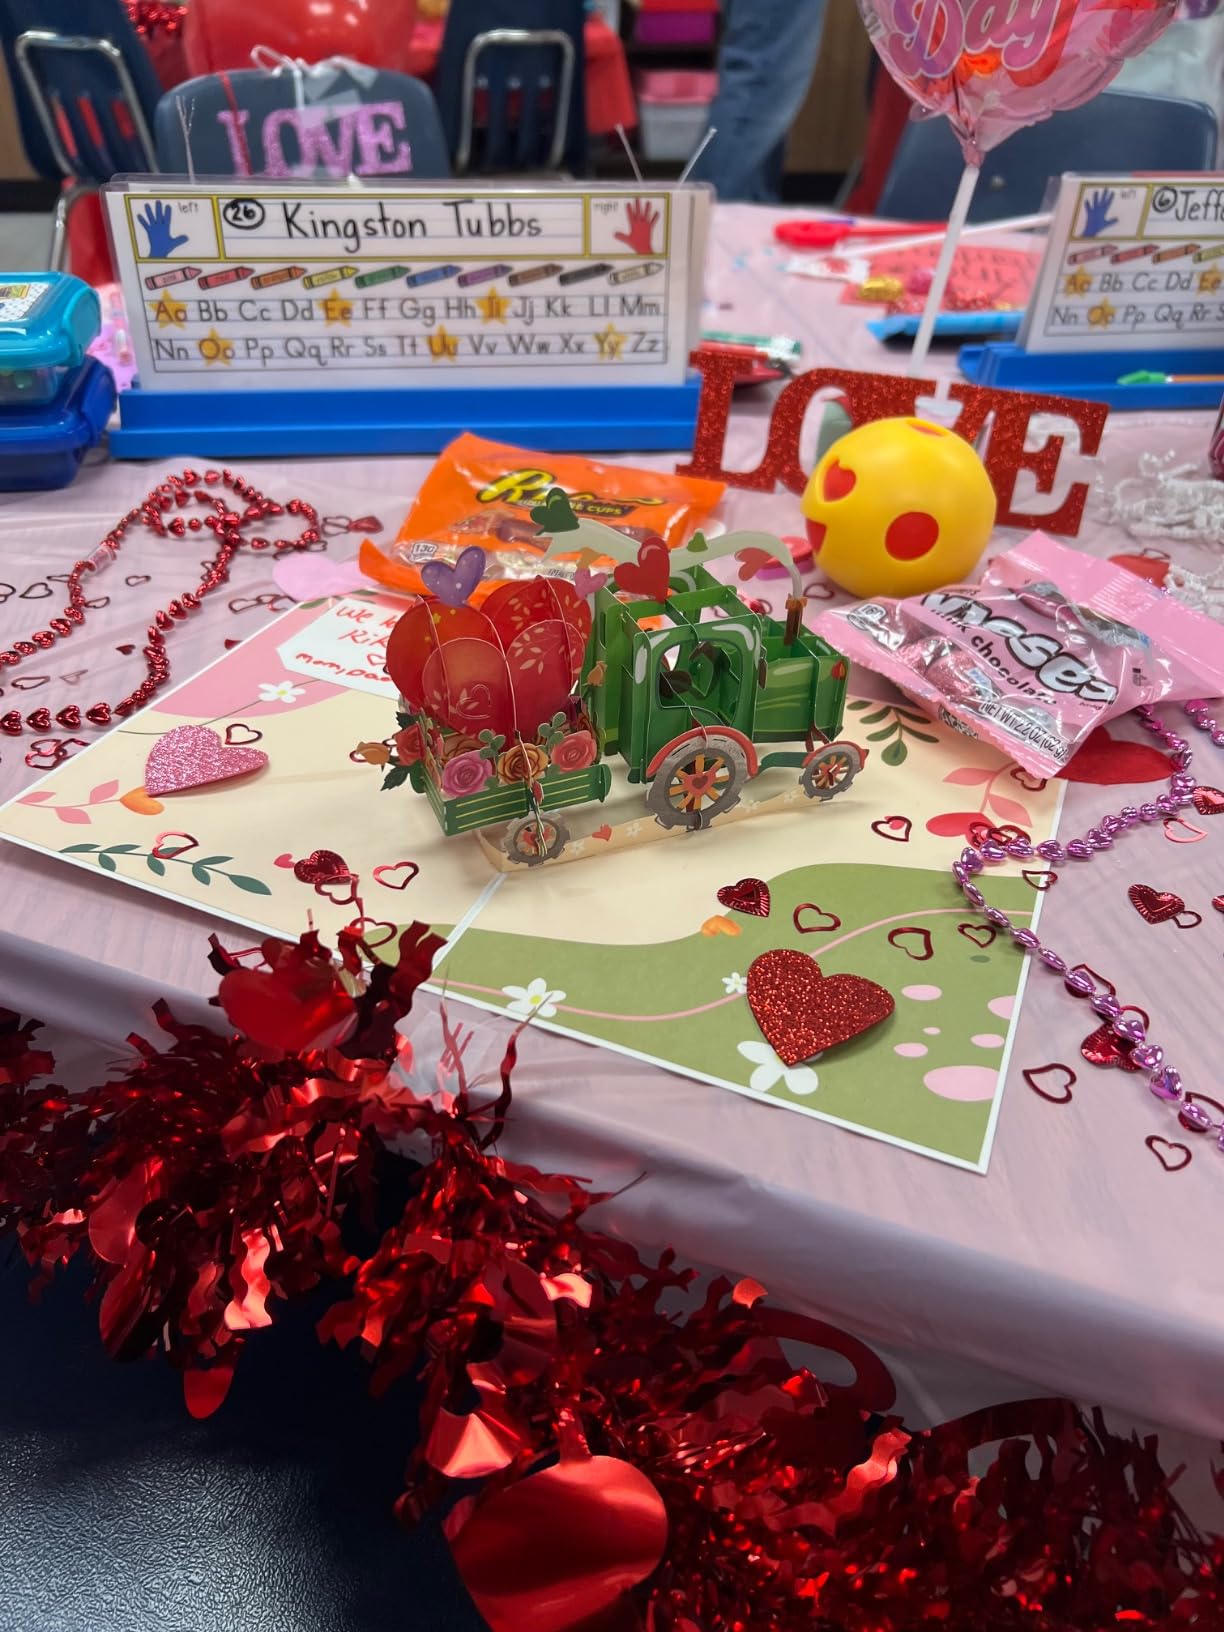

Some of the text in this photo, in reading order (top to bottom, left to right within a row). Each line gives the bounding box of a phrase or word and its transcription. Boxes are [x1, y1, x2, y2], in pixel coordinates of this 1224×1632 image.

[178, 202, 199, 214] left
[593, 202, 618, 216] right
[282, 198, 542, 253] Kingston Tubbs
[1100, 272, 1124, 292] Bb
[1131, 271, 1158, 291] Cc
[1165, 271, 1194, 291] Dd
[155, 300, 188, 322] Aa
[198, 300, 228, 322] Bb
[238, 300, 272, 321] Cc
[281, 299, 314, 321] Dd
[324, 299, 353, 320] Ee
[363, 298, 388, 319] Ff
[399, 298, 436, 327] Gg
[445, 297, 477, 318] Hh
[512, 296, 535, 326] Jj
[545, 296, 571, 317] Kk
[619, 295, 661, 316] Mm
[1052, 306, 1079, 326] Nn
[1122, 304, 1146, 333] Pp
[1154, 303, 1184, 330] Qq
[1189, 302, 1212, 321] Rr
[155, 331, 660, 367] Nn Oo Pp Qq Rr Ss Tt Uu Vv Ww Xx Yy Zz
[586, 504, 622, 515] CUPS
[335, 606, 374, 624] We
